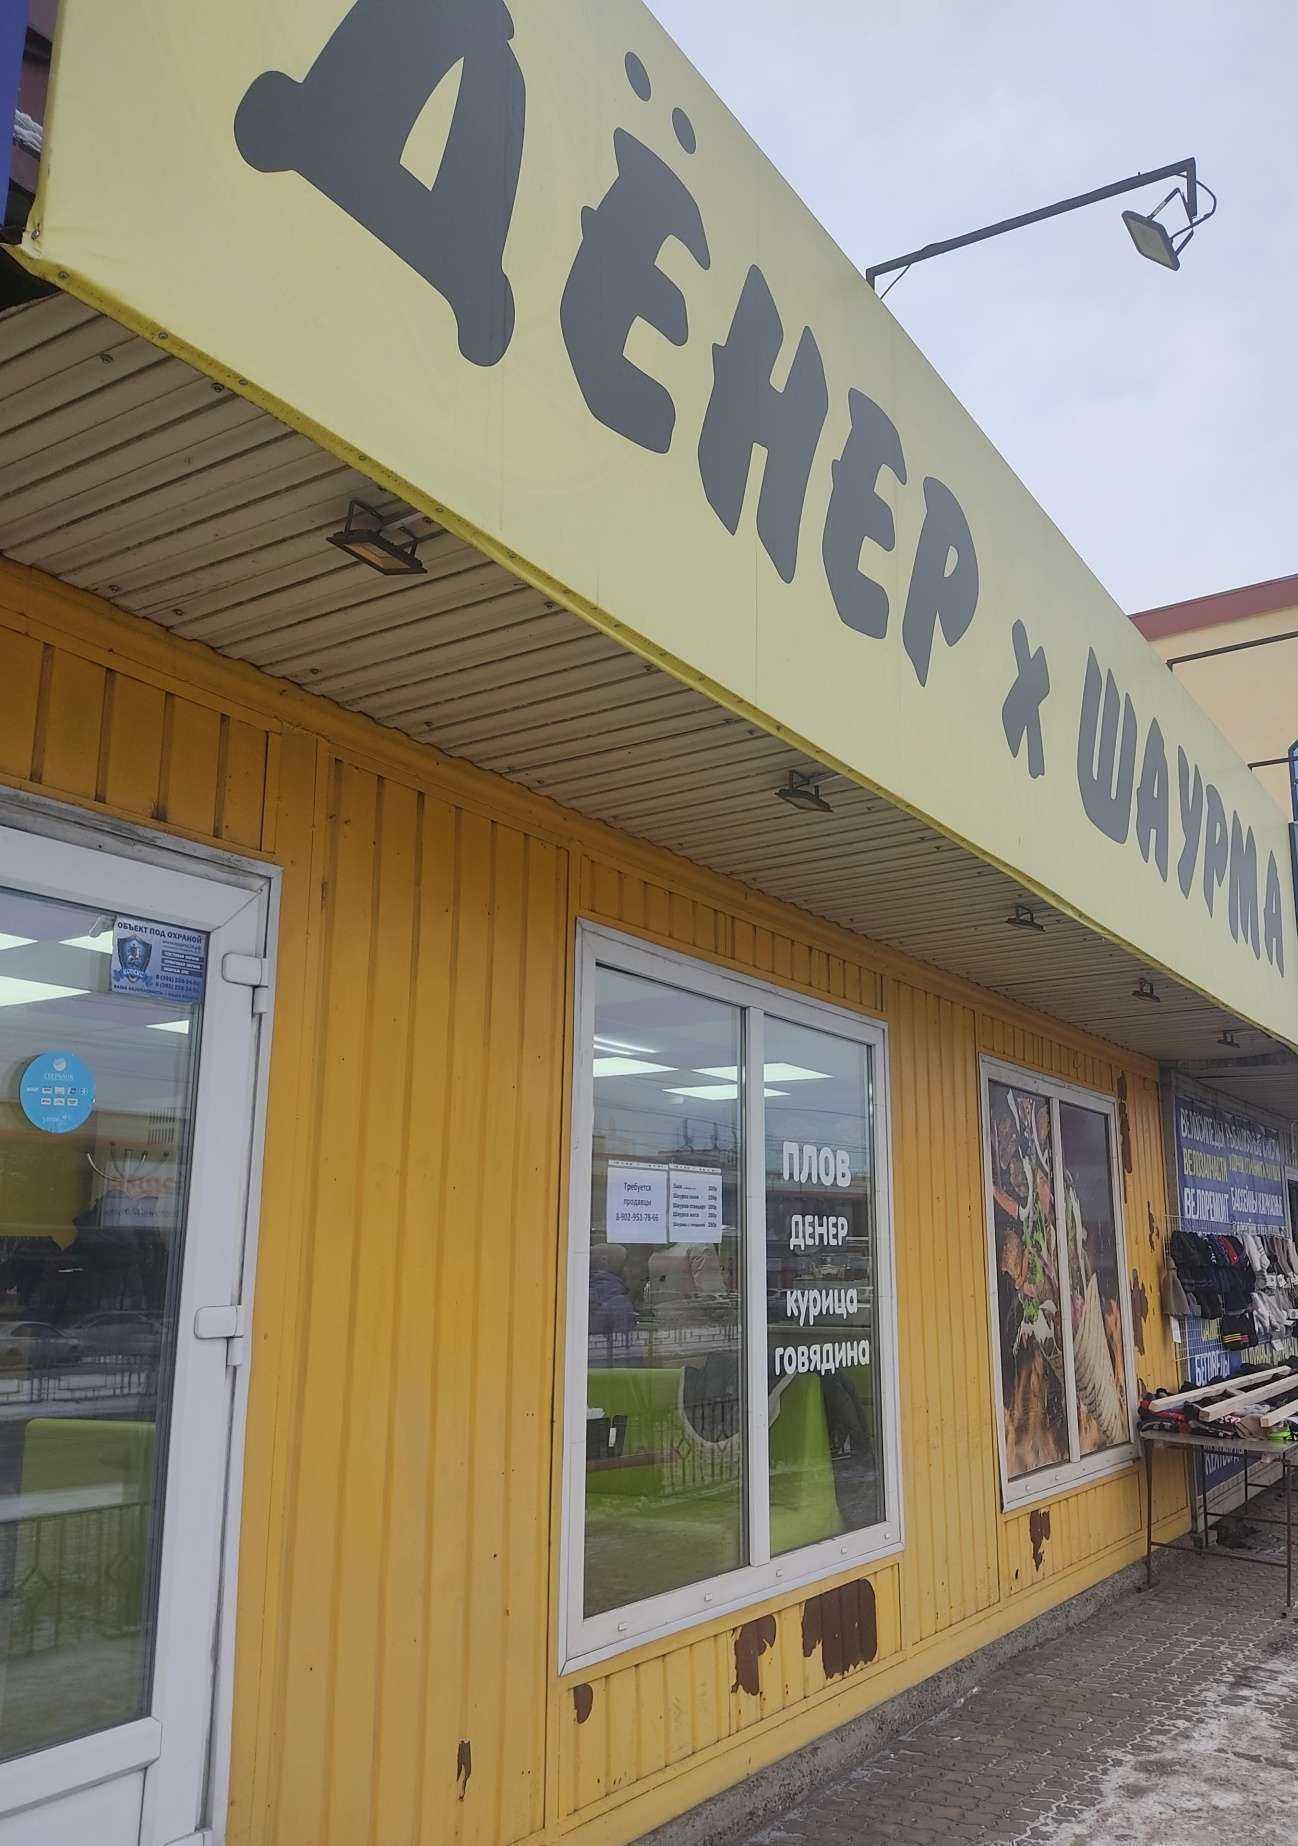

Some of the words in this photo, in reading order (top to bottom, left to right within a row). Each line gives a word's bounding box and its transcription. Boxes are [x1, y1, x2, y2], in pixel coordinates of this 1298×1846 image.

[1076, 645, 1285, 978] ШАУРМА
[117, 921, 147, 934] ОБЪЕКТ
[149, 928, 166, 938] ПОД
[167, 931, 202, 944] ОХРАНОЙ
[782, 1141, 852, 1188] ПЛОВ
[624, 1182, 652, 1193] Требуется
[1184, 1187, 1230, 1222] ВЕЛОРЕМОНТ
[789, 1214, 848, 1250] ДЕНЕР
[786, 1288, 858, 1327] курица
[774, 1339, 870, 1376] говядина
